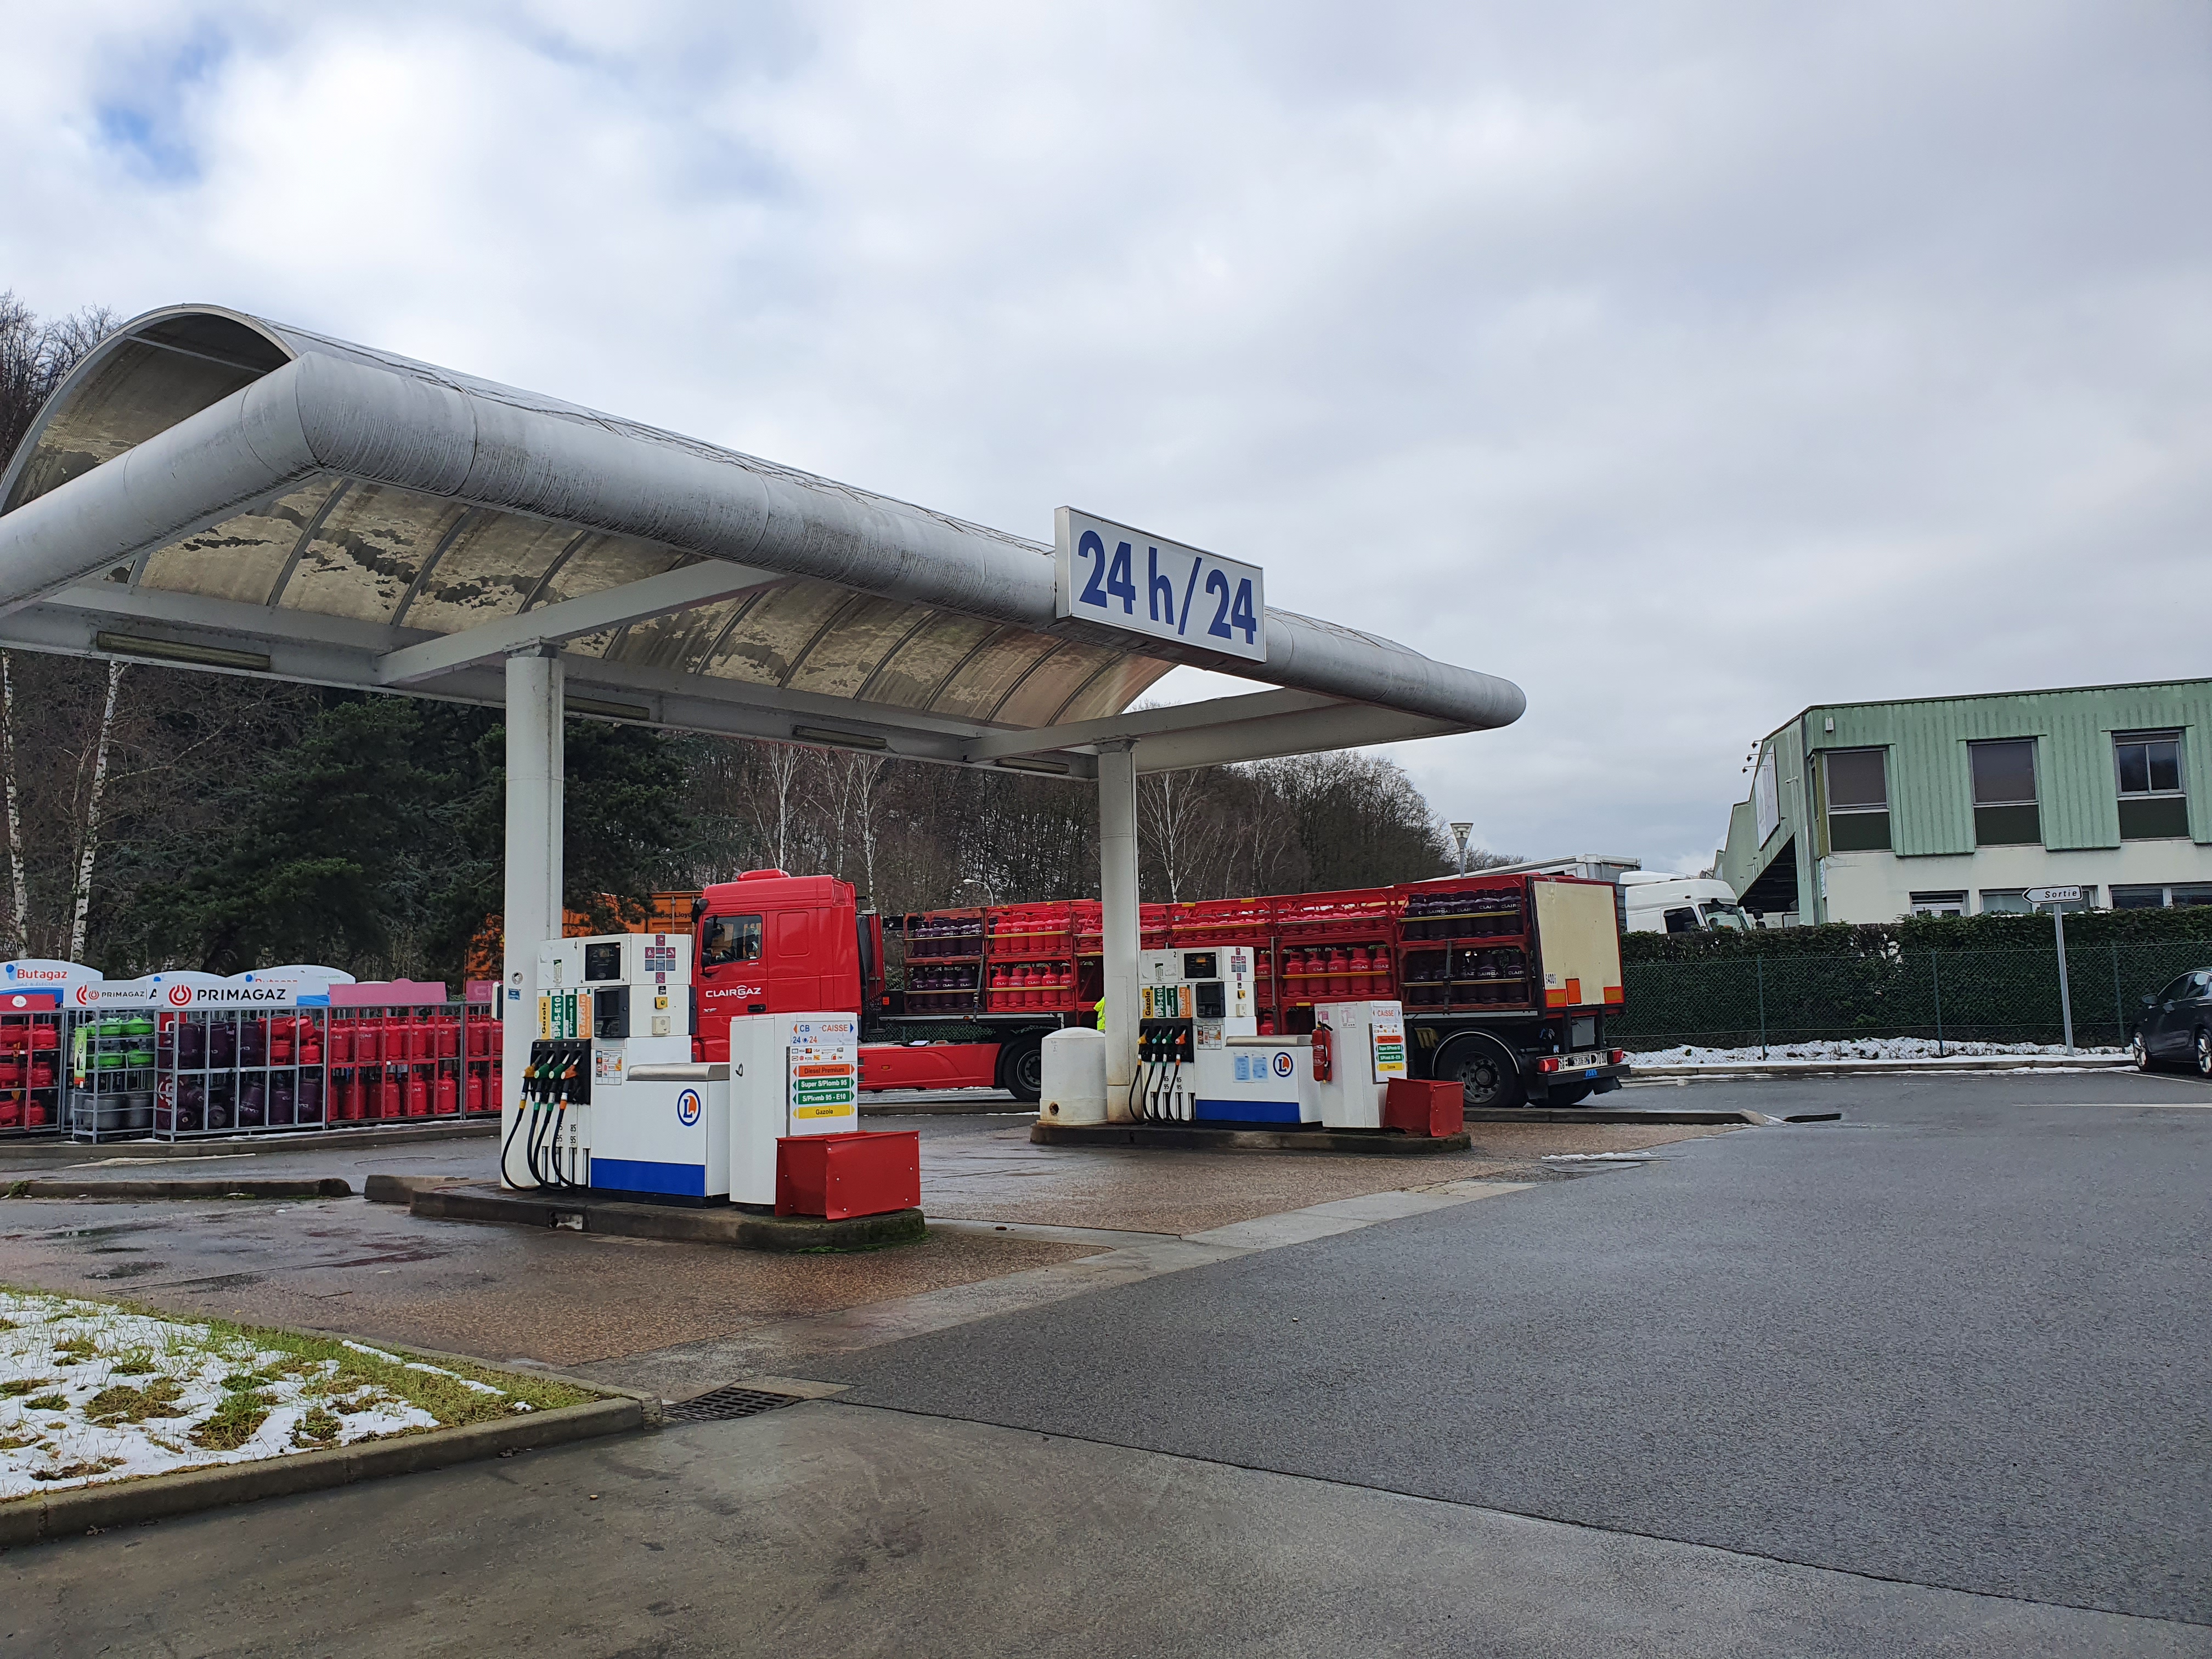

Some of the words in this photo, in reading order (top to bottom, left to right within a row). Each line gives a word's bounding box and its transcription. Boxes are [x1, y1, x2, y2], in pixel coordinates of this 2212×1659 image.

[1078, 530, 1136, 615] 24
[2044, 890, 2077, 898] Sortie
[574, 941, 577, 950] 4
[17, 969, 67, 980] Butagaz
[197, 989, 286, 1001] PRIMAGAZ
[706, 986, 761, 998] CLAIRGAZ
